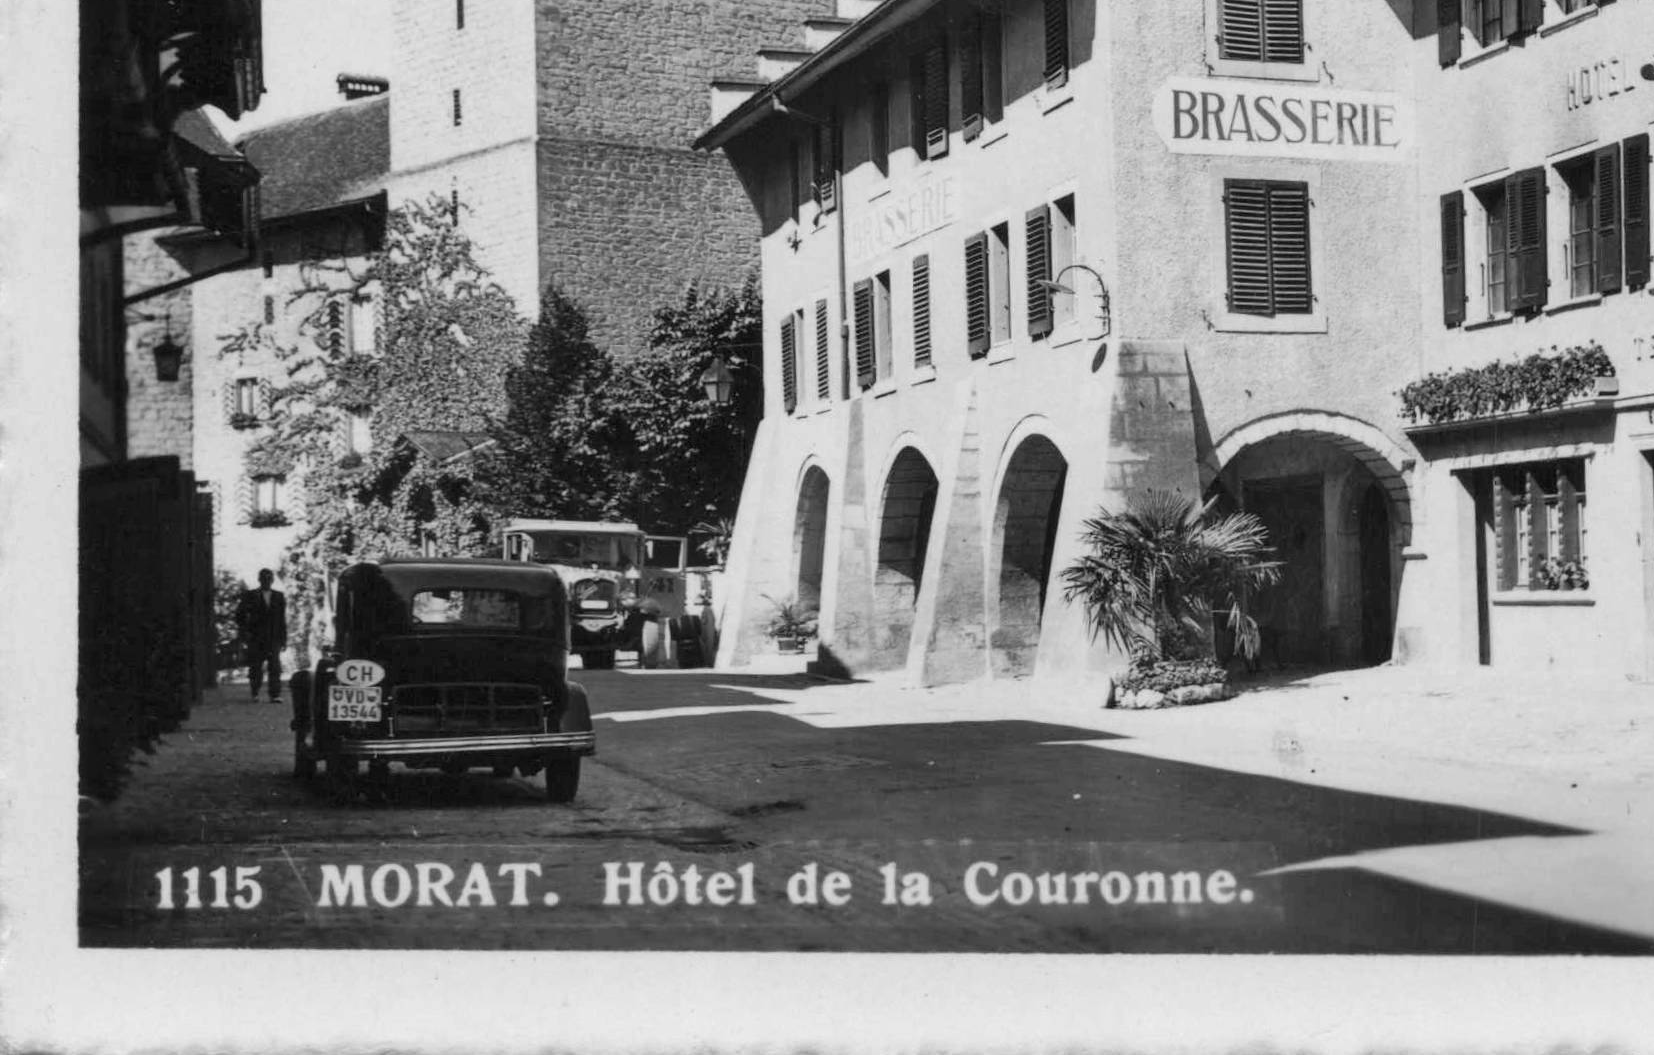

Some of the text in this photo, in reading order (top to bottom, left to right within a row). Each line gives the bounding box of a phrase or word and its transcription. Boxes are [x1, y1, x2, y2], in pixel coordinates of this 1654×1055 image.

[1171, 89, 1402, 150] BRASSERIE
[849, 175, 954, 260] BRASSERIE
[346, 665, 374, 682] CH
[345, 689, 365, 704] VD
[332, 705, 377, 719] 13544
